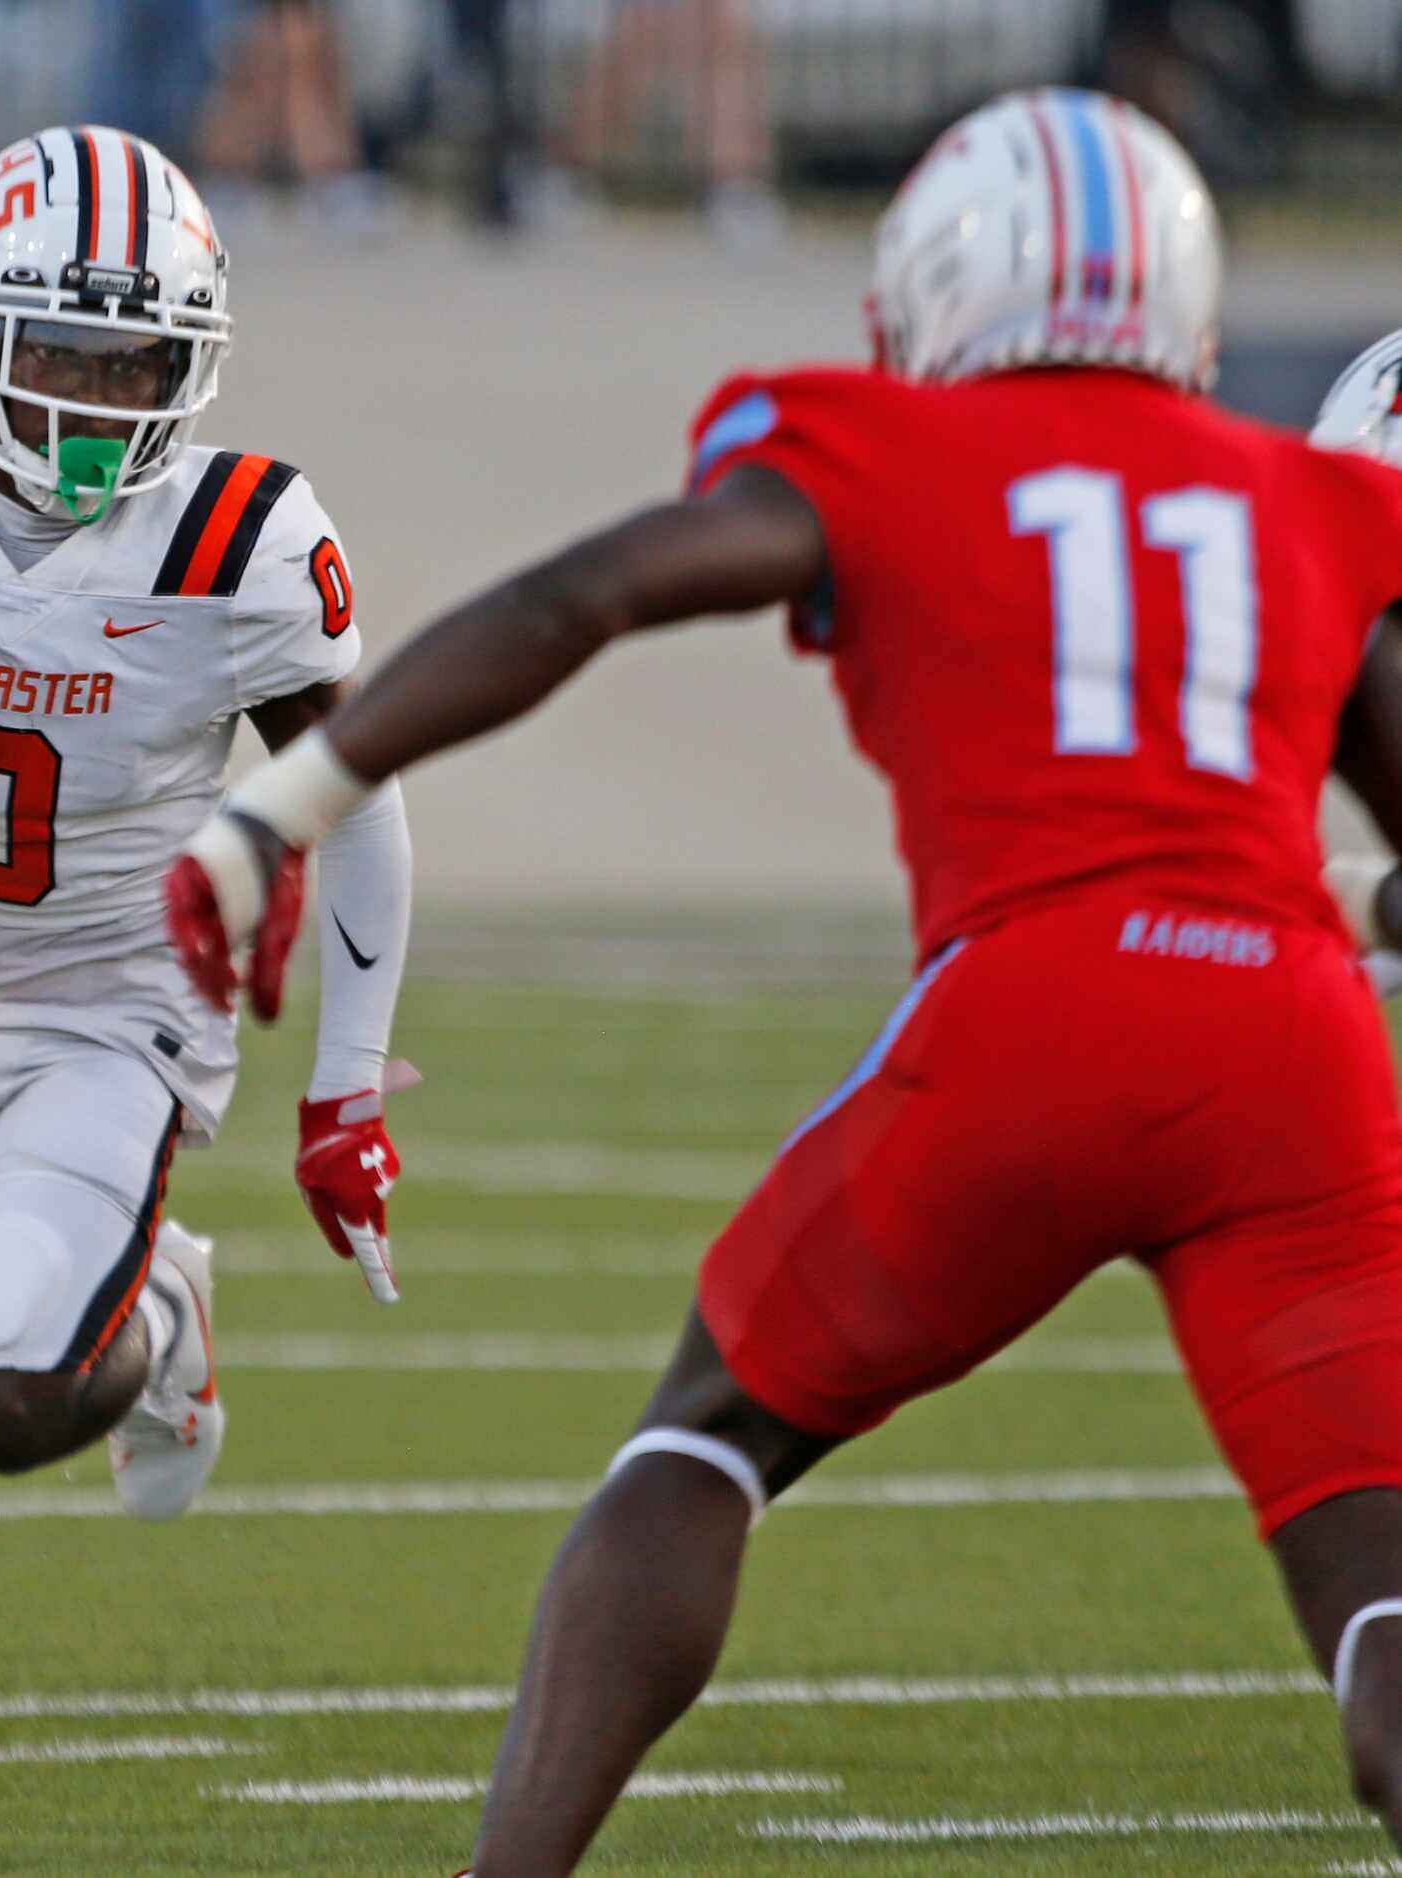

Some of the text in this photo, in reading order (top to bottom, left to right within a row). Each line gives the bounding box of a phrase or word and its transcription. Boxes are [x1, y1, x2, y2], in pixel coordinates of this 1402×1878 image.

[309, 536, 352, 640] 0
[1007, 463, 1260, 784] 11
[1118, 909, 1277, 967] RAIDERS
